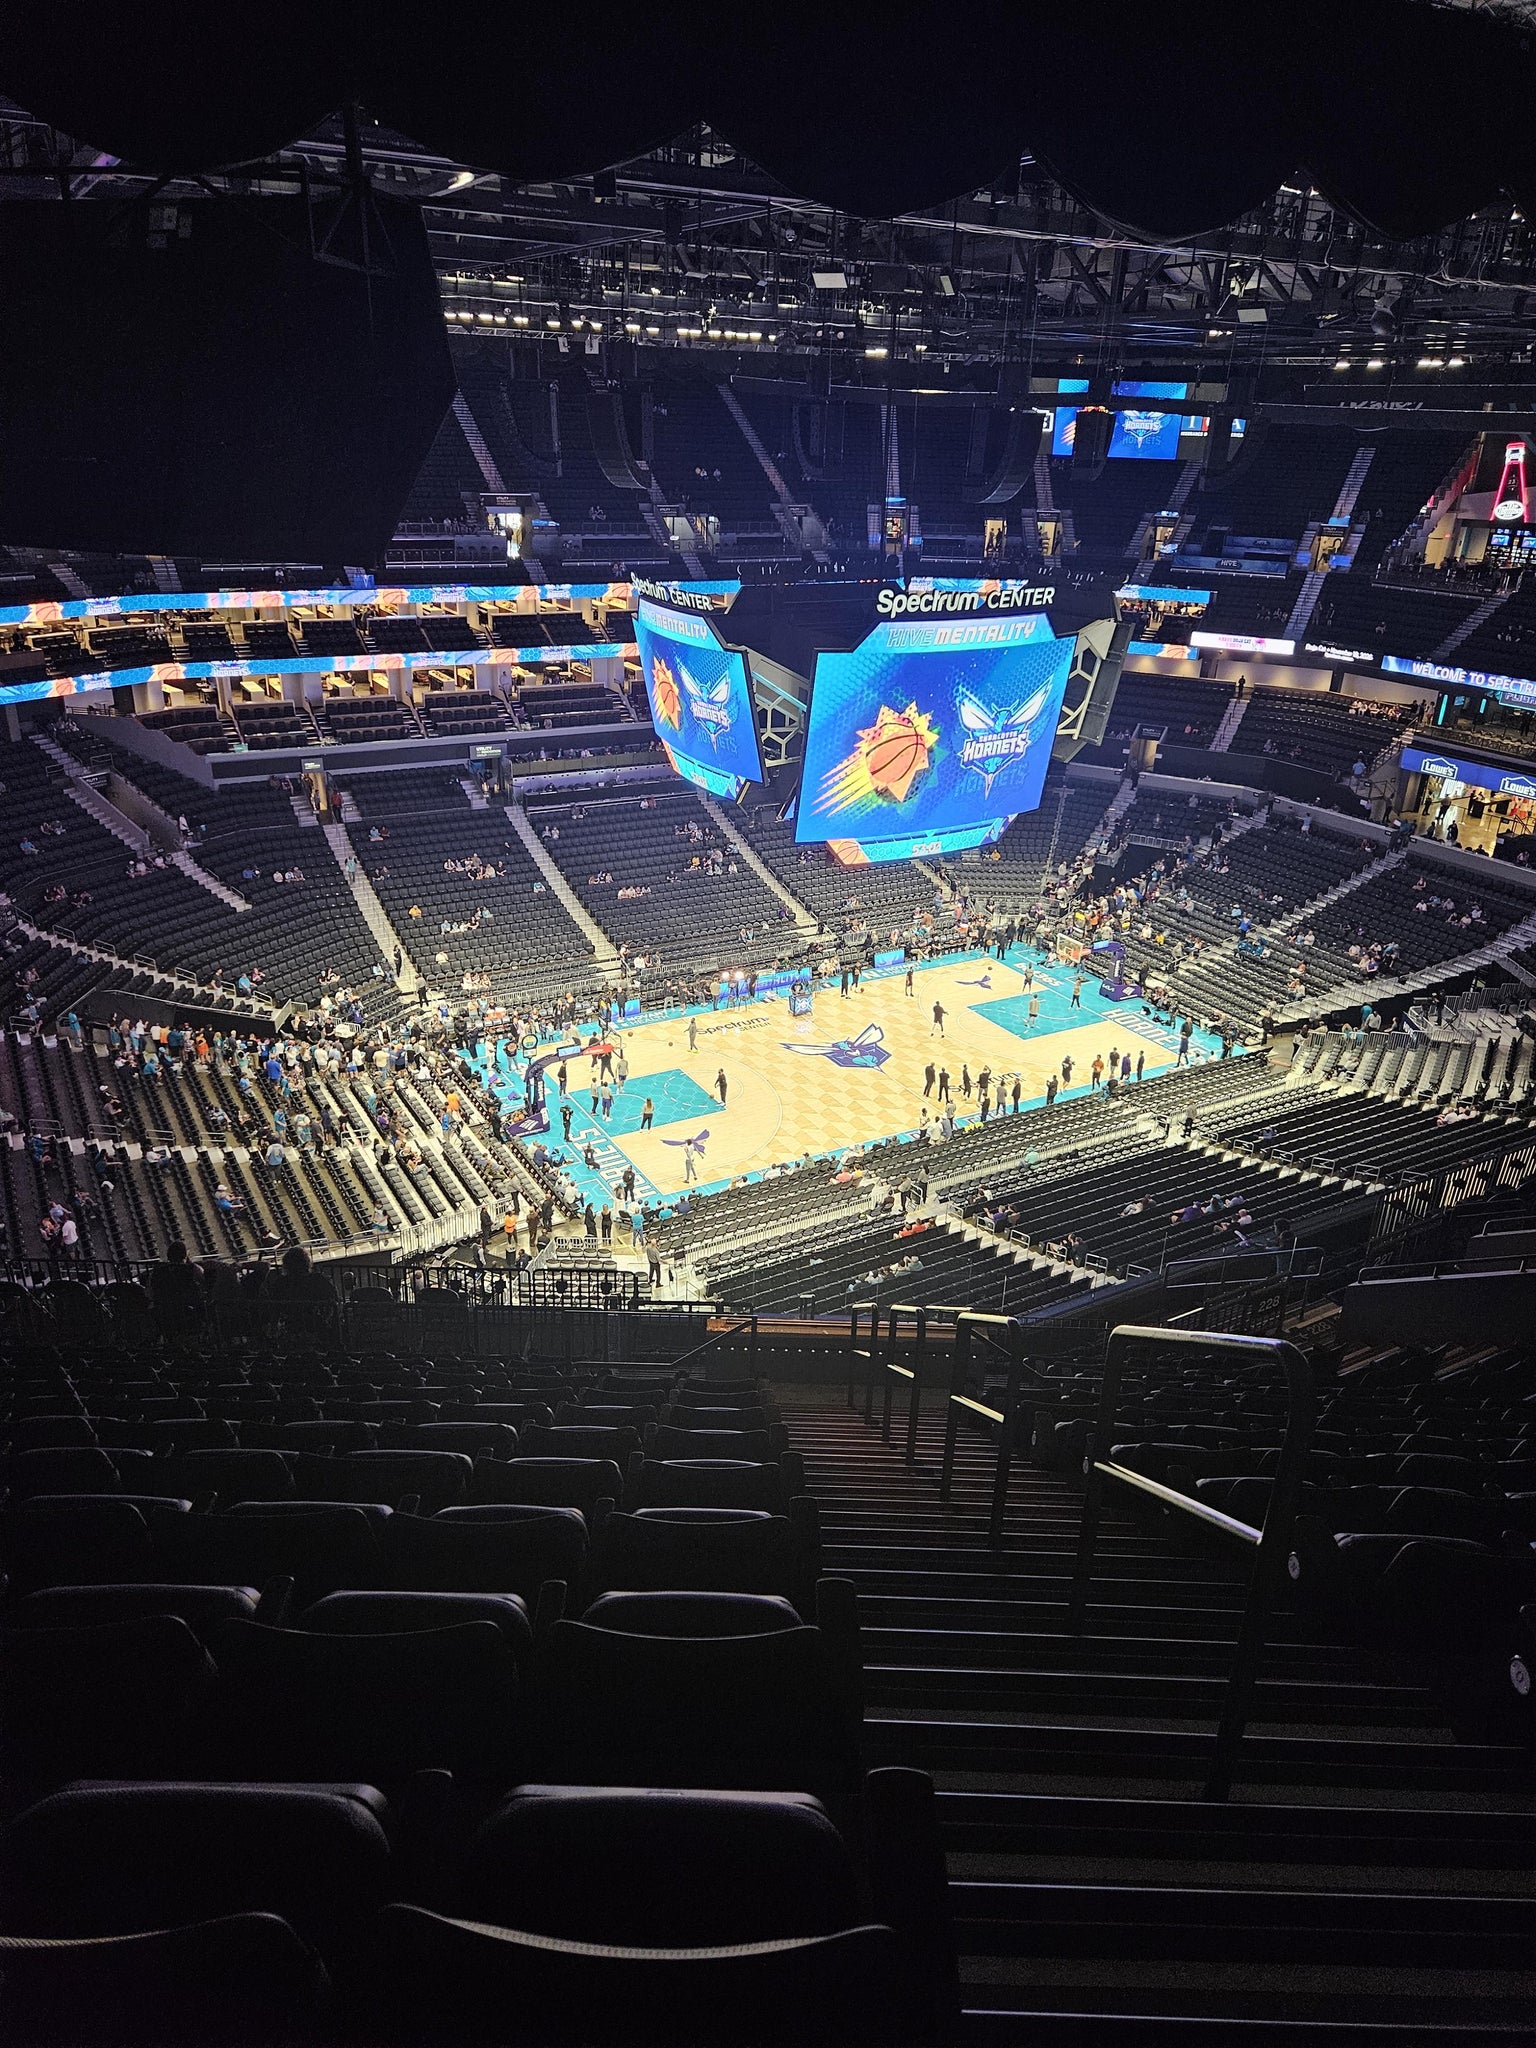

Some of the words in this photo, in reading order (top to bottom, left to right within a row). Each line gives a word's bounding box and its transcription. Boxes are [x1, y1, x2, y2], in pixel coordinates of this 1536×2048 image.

[1220, 559, 1238, 567] HIVE
[630, 571, 669, 602] Spectrum
[669, 590, 715, 611] CENTER
[876, 589, 979, 618] Spectrum
[987, 587, 1056, 608] CENTER
[886, 628, 936, 648] HIVE
[933, 621, 1037, 646] MENTALITY
[1412, 663, 1467, 683] WELCOME
[1469, 673, 1486, 686] TO
[1487, 677, 1536, 692] SPECTR
[963, 732, 1027, 763] HORNETS
[1425, 761, 1455, 777] LOWE'S
[696, 1017, 766, 1035] Spectrum
[1258, 1295, 1280, 1312] 228
